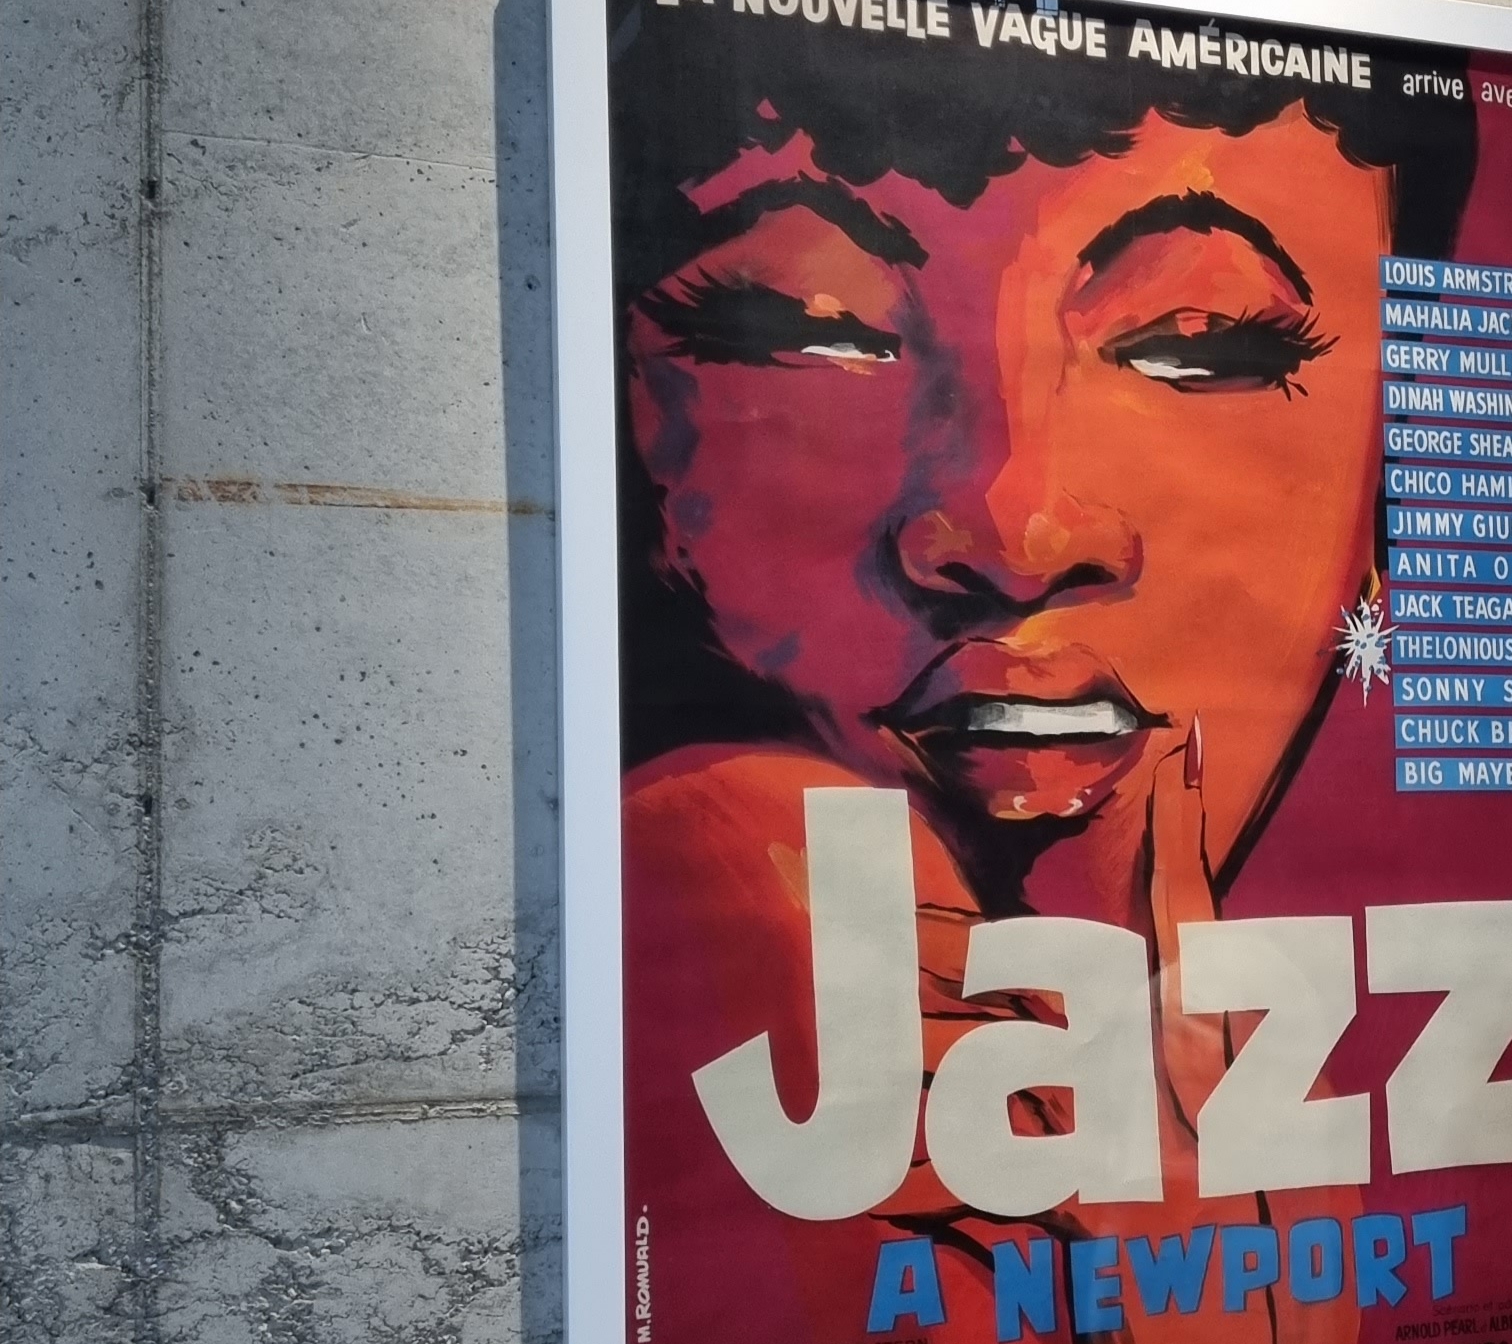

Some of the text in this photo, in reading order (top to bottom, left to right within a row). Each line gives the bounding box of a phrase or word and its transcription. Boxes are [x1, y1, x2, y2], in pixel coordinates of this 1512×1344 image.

[971, 2, 1106, 56] VAGUE
[1128, 18, 1371, 89] AMÉRICAINE
[1403, 70, 1464, 100] arrive
[1385, 261, 1435, 287] LOUIS
[1385, 303, 1473, 332] MAHALIA
[1386, 344, 1450, 371] GERRY
[1389, 386, 1443, 412] DINAH
[1388, 428, 1462, 455] GEORGE
[1390, 469, 1451, 496] CHICO
[1393, 511, 1463, 536] JIMMY
[1397, 553, 1477, 578] ANITA
[1395, 594, 1443, 618] JACK
[1402, 677, 1485, 702] SONNY
[1401, 719, 1480, 743] CHUCK
[1405, 761, 1442, 785] BIG
[866, 1205, 1467, 1343] A NEWPORT
[1396, 1322, 1440, 1341] ARNOLD
[1444, 1318, 1479, 1334] PEARL
